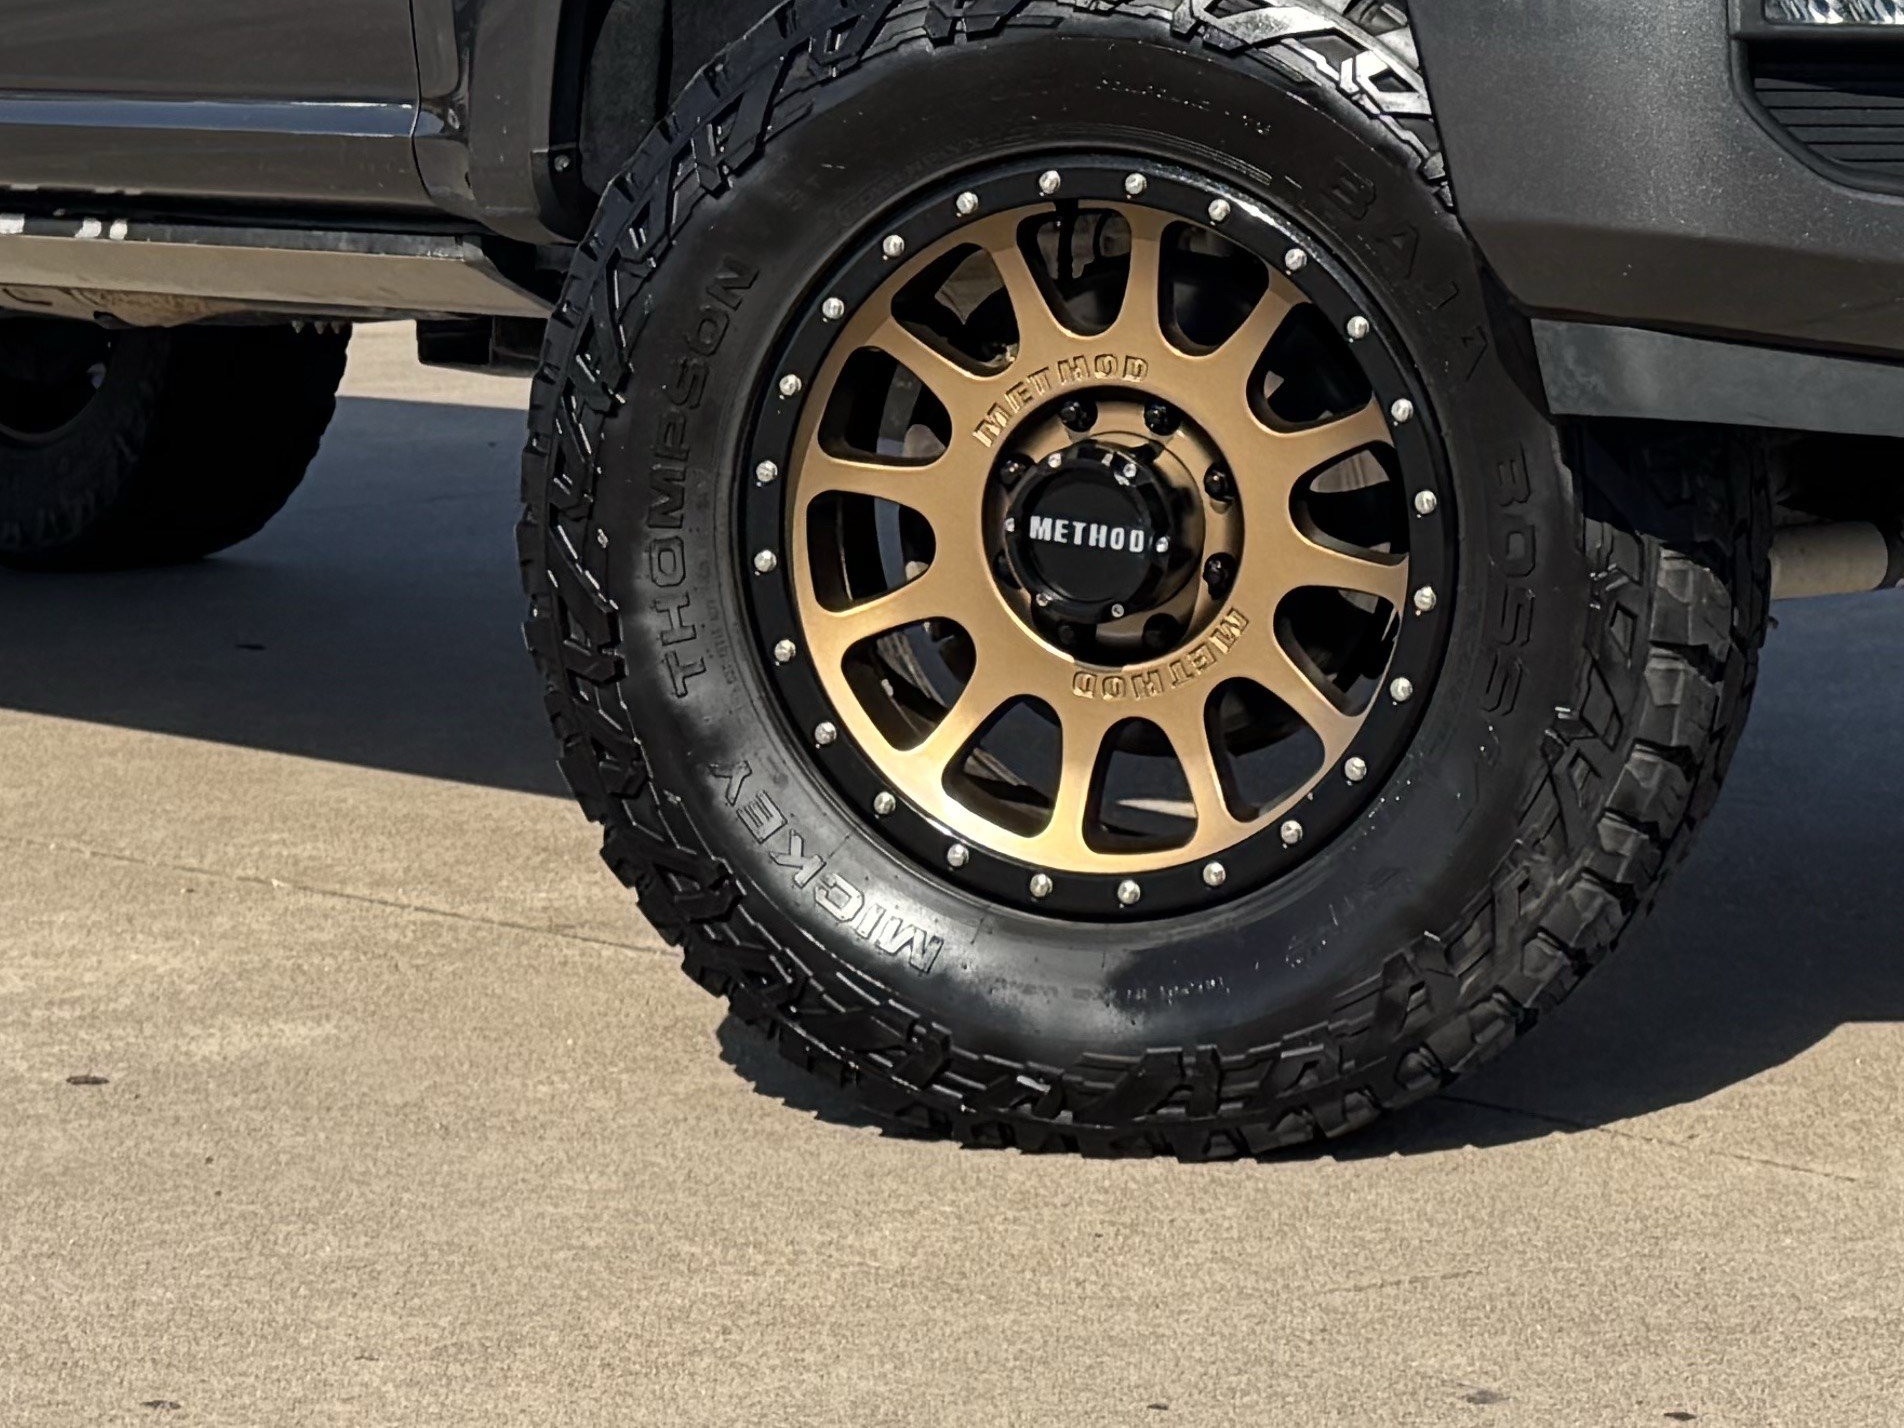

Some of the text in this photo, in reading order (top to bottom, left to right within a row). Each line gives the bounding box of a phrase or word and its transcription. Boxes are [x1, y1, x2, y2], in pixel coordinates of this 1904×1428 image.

[971, 353, 1149, 448] METHOD
[1028, 515, 1145, 553] METHOD
[647, 255, 944, 976] MICKEY THOMPSON
[1071, 606, 1250, 700] METHOD
